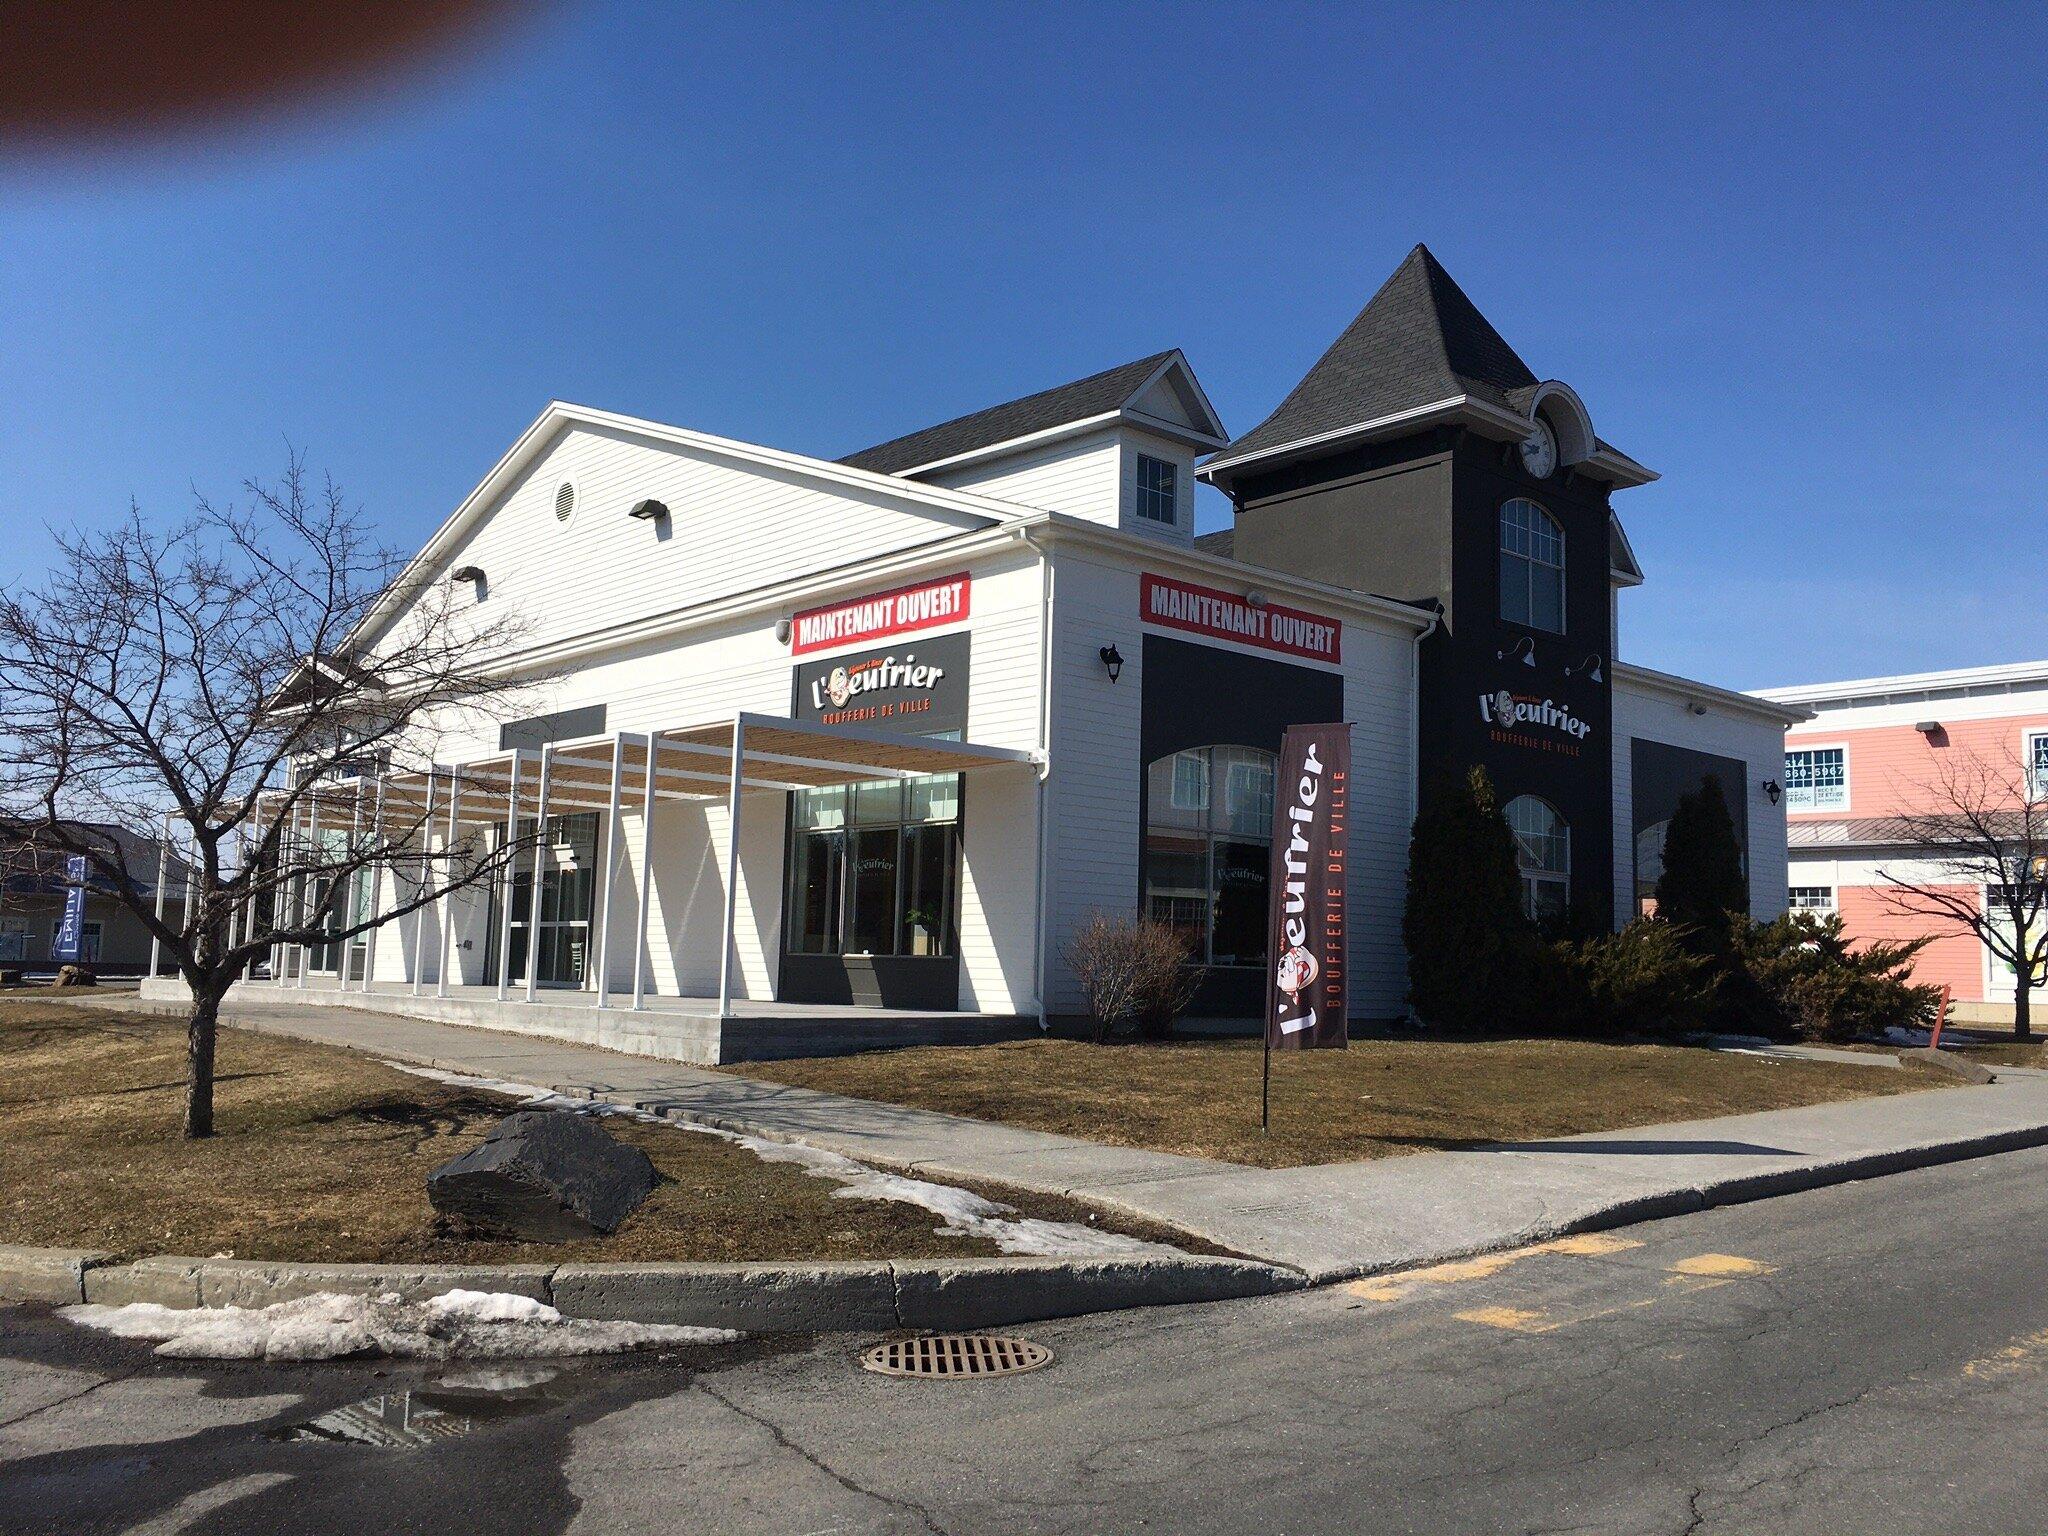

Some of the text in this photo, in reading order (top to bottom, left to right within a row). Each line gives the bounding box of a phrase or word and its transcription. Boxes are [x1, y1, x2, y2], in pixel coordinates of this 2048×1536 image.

[799, 582, 963, 646] MAINTENANT OUVERT
[1151, 584, 1335, 654] MAINTENANT OUVERT
[822, 698, 931, 725] BOUFFERIE DE VILLE
[1326, 772, 1345, 1008] BOUFFERIE DE VILLE
